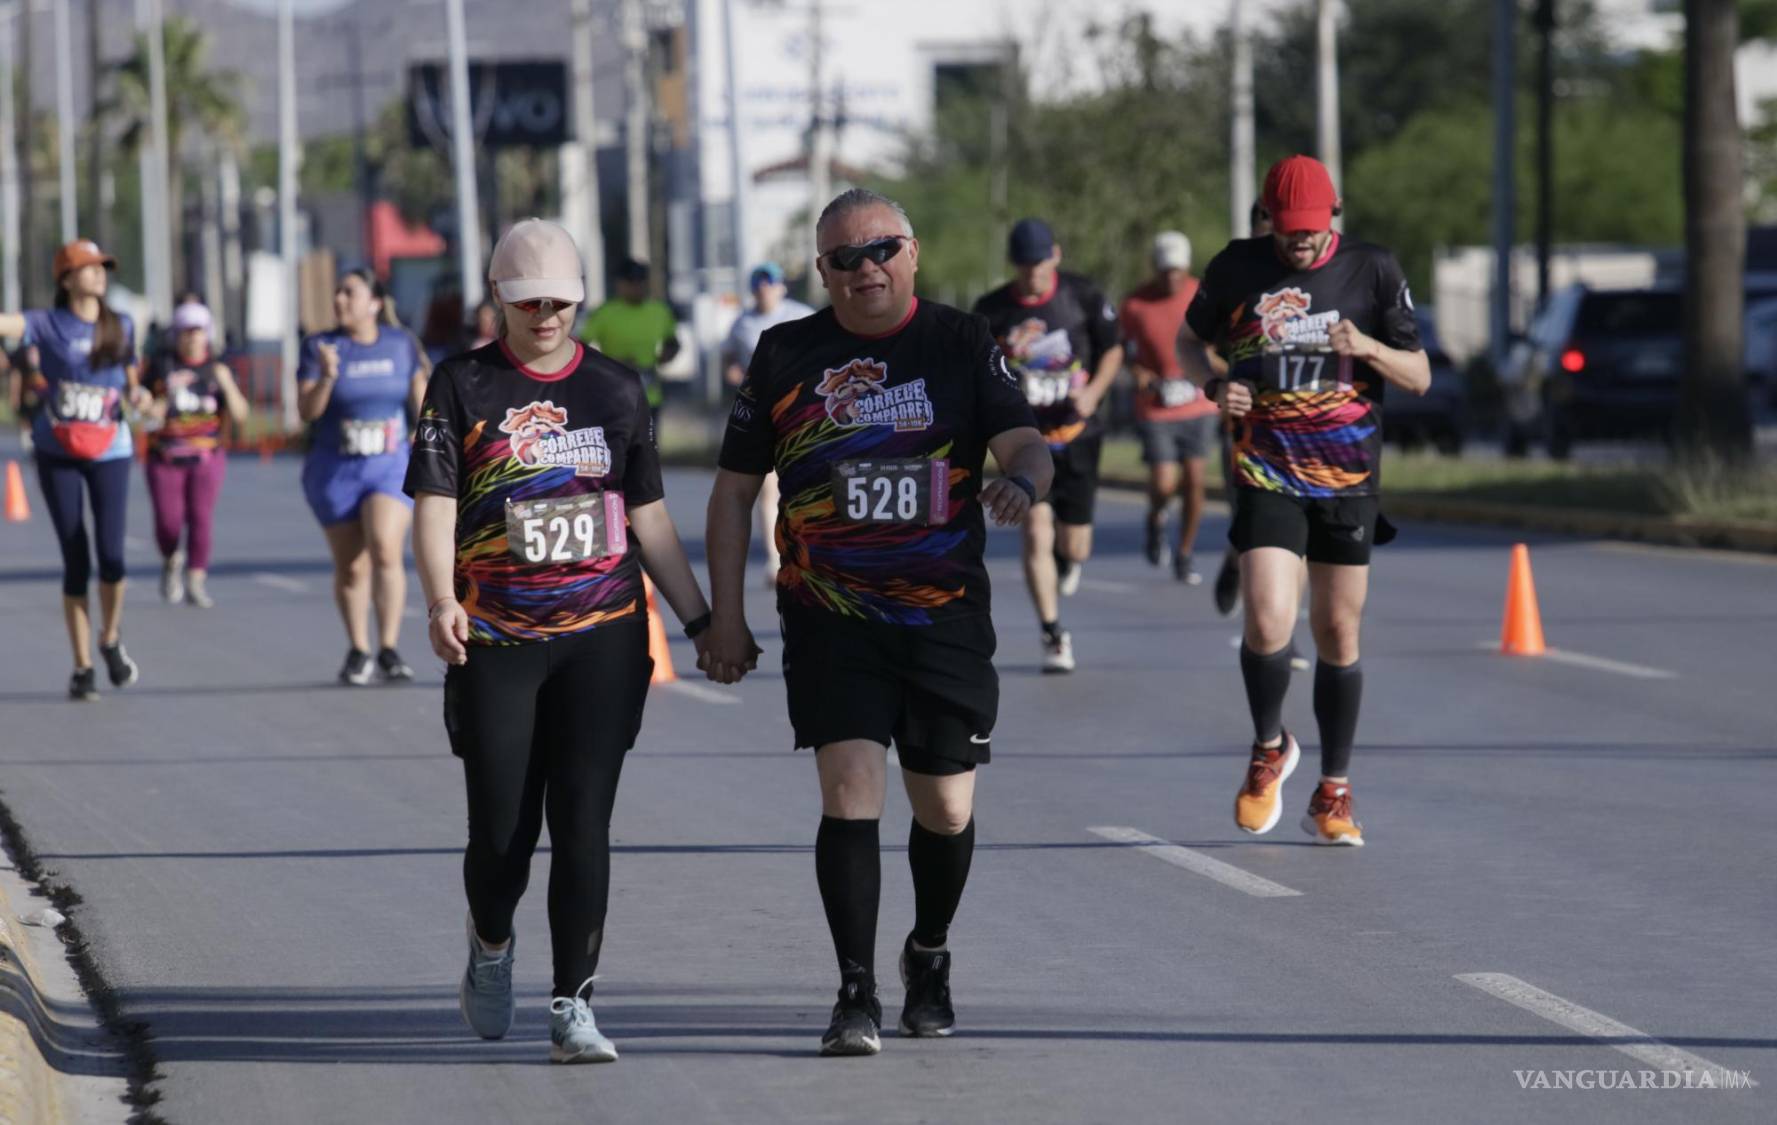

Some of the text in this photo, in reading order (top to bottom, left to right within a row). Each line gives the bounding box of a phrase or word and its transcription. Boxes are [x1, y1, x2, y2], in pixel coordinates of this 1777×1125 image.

[1280, 356, 1325, 391] 177
[848, 476, 917, 520] 528
[523, 514, 594, 562] 529
